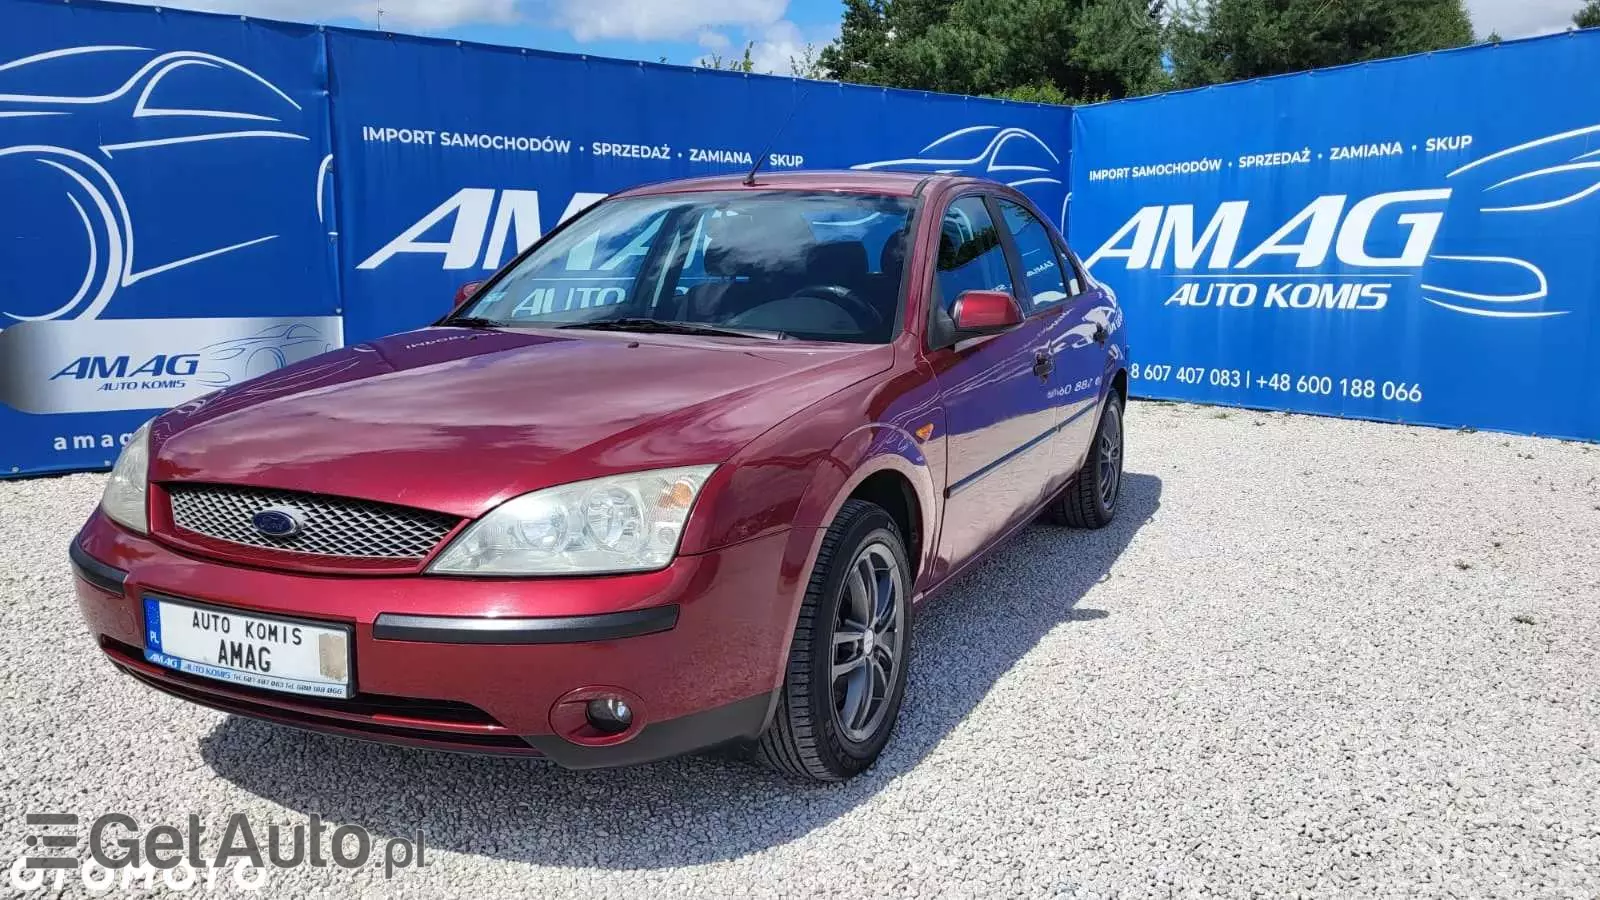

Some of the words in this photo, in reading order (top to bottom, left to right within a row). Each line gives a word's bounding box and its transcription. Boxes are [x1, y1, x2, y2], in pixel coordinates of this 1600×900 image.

[362, 126, 436, 145] IMPORT
[440, 131, 571, 153] SAMOCHODÓW
[592, 142, 671, 160] SPRZEDAŻ
[689, 148, 752, 164] ZAMIANA
[769, 153, 804, 167] SKUP
[1089, 167, 1130, 181] IMPORT
[1131, 157, 1223, 178] SAMOCHODÓW
[1239, 147, 1312, 168] SPRZEDAŻ
[1329, 141, 1404, 160] ZAMIANA
[1425, 135, 1472, 152] SKUP
[511, 287, 626, 317] AUTO
[1164, 283, 1258, 308] AUTO
[1263, 283, 1392, 310] KOMIS
[97, 381, 138, 391] AUTO
[141, 379, 187, 390] KOMIS
[1144, 363, 1172, 381] 607
[1176, 366, 1205, 385] 407
[1209, 368, 1240, 387] 083
[1255, 372, 1290, 391] +48
[1296, 375, 1332, 395] 600
[1339, 378, 1375, 398] 188
[1382, 380, 1422, 402] 066
[150, 631, 160, 644] PL
[192, 611, 231, 634] AUTO
[245, 620, 303, 645] KOMIS
[217, 639, 271, 672] AMAG
[206, 667, 231, 679] KOMIS
